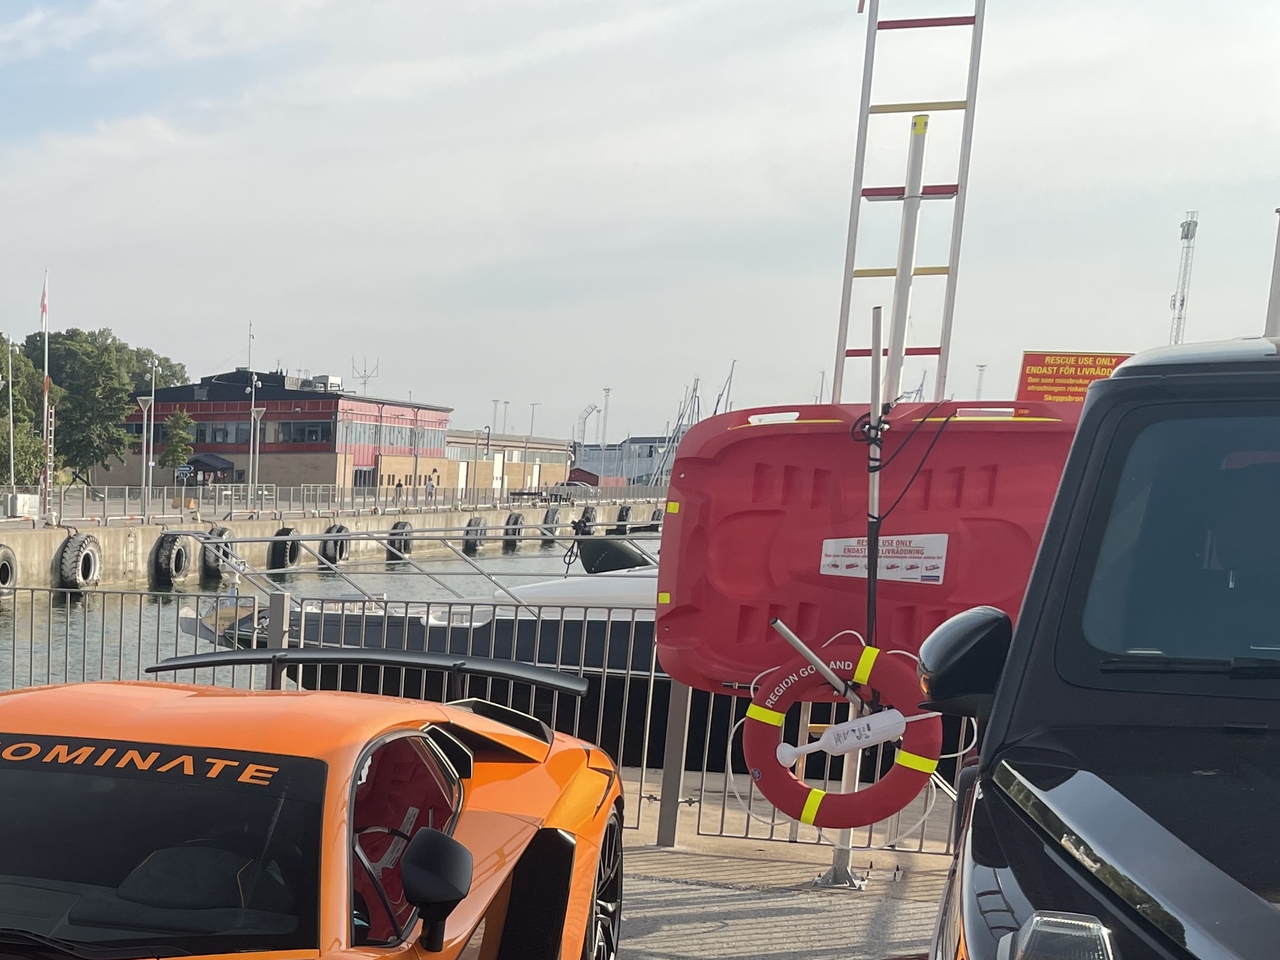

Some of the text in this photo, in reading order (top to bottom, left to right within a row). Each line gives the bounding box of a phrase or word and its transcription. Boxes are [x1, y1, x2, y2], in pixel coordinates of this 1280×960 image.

[1045, 356, 1117, 366] RESCUE USE ONLY
[1026, 366, 1113, 376] ENDAST FÖR LIVRÄDD
[881, 539, 895, 547] USE
[895, 539, 913, 547] ONLY
[843, 547, 867, 555] ENDAST
[765, 660, 853, 708] REGION GOAND
